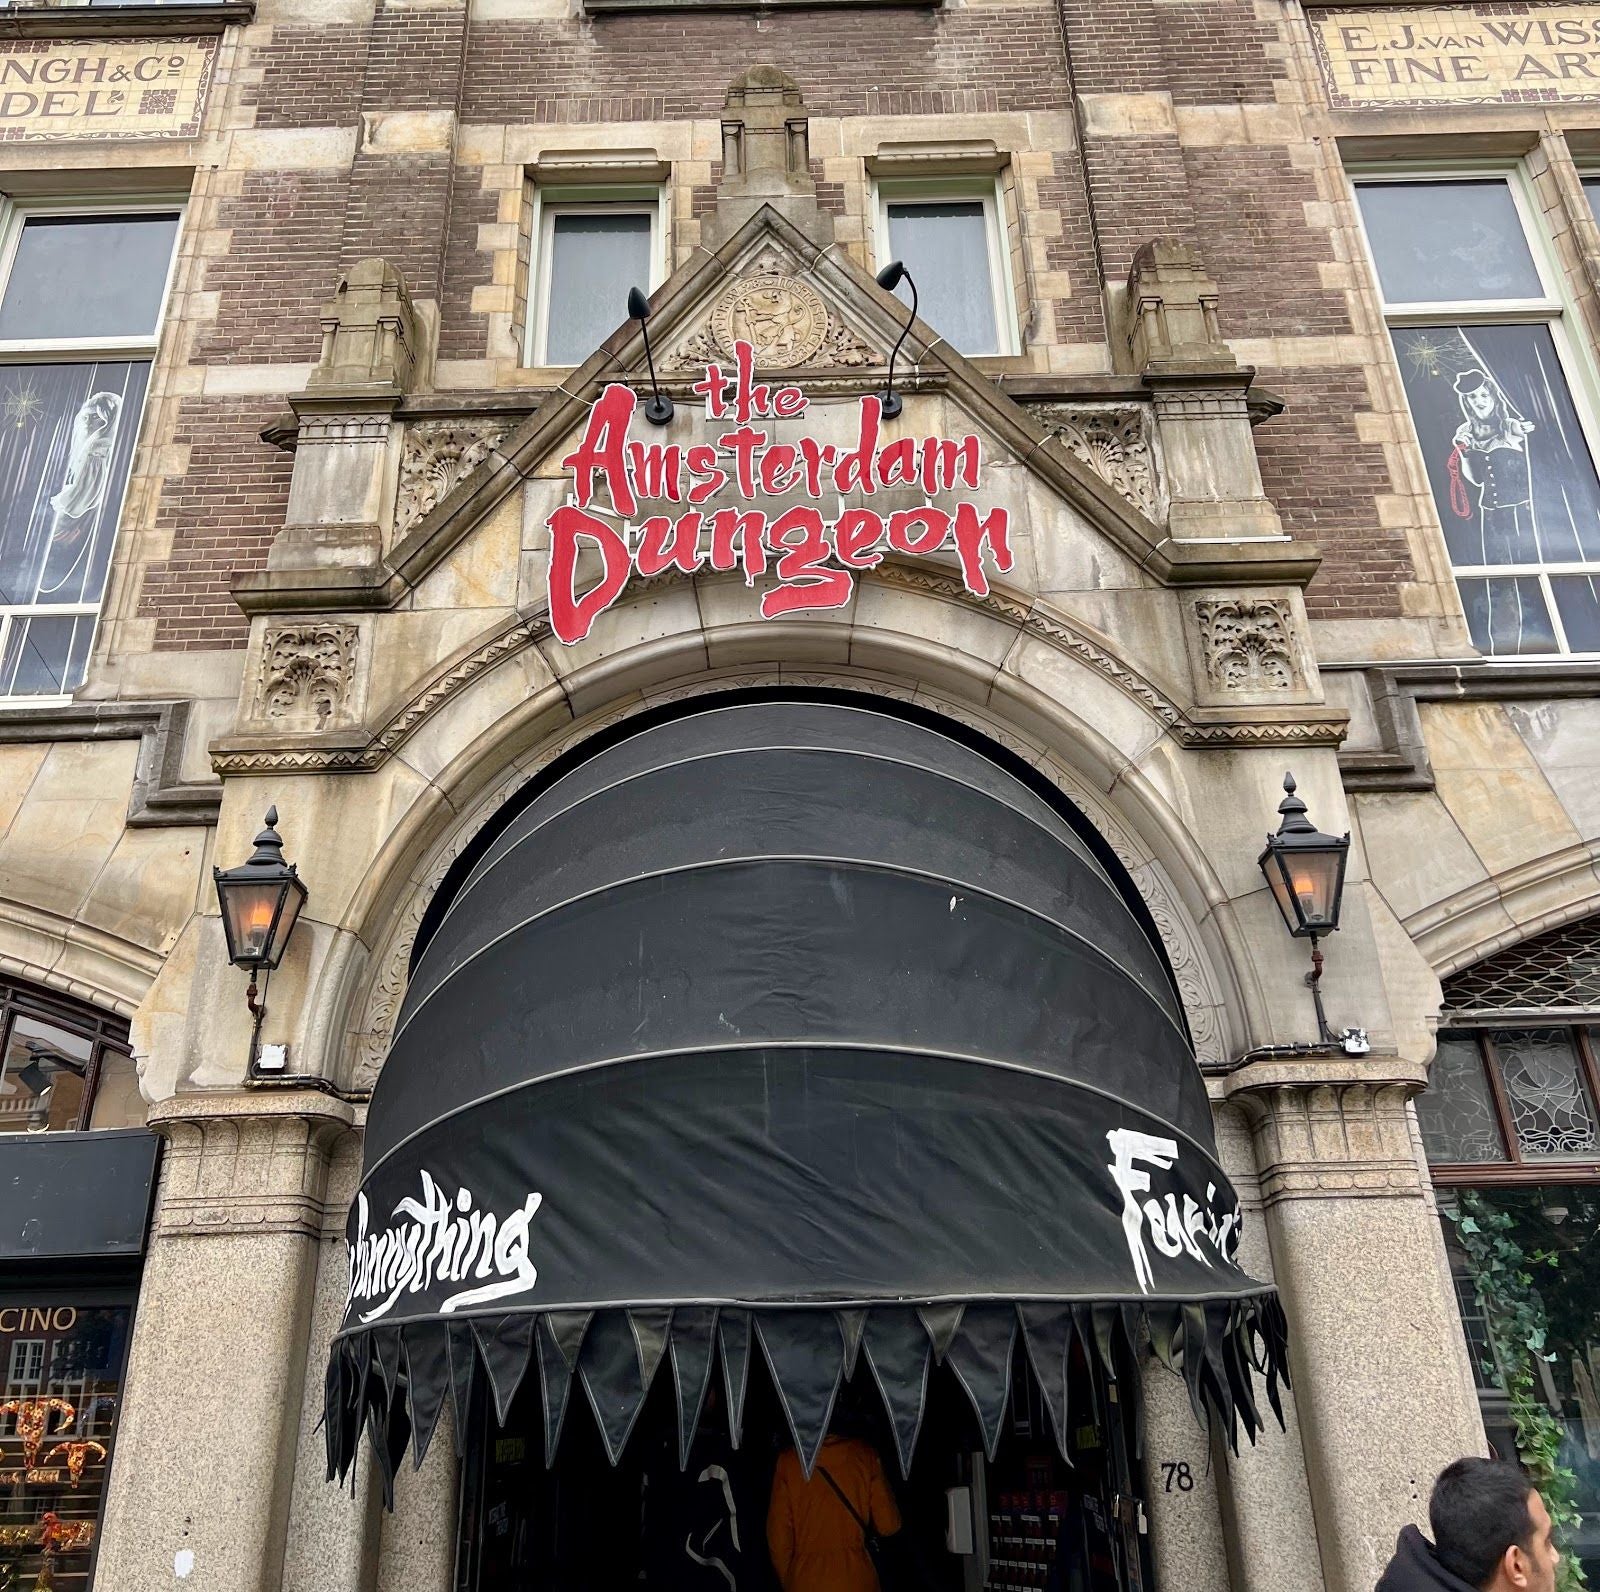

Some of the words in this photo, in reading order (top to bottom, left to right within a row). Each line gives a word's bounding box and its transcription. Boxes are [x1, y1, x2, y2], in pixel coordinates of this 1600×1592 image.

[1481, 19, 1600, 46] WIS
[1350, 55, 1489, 85] FINE
[693, 339, 811, 425] the
[562, 382, 982, 518] Amsterdam
[545, 501, 1016, 646] Dungeon
[1160, 1461, 1194, 1494] 78
